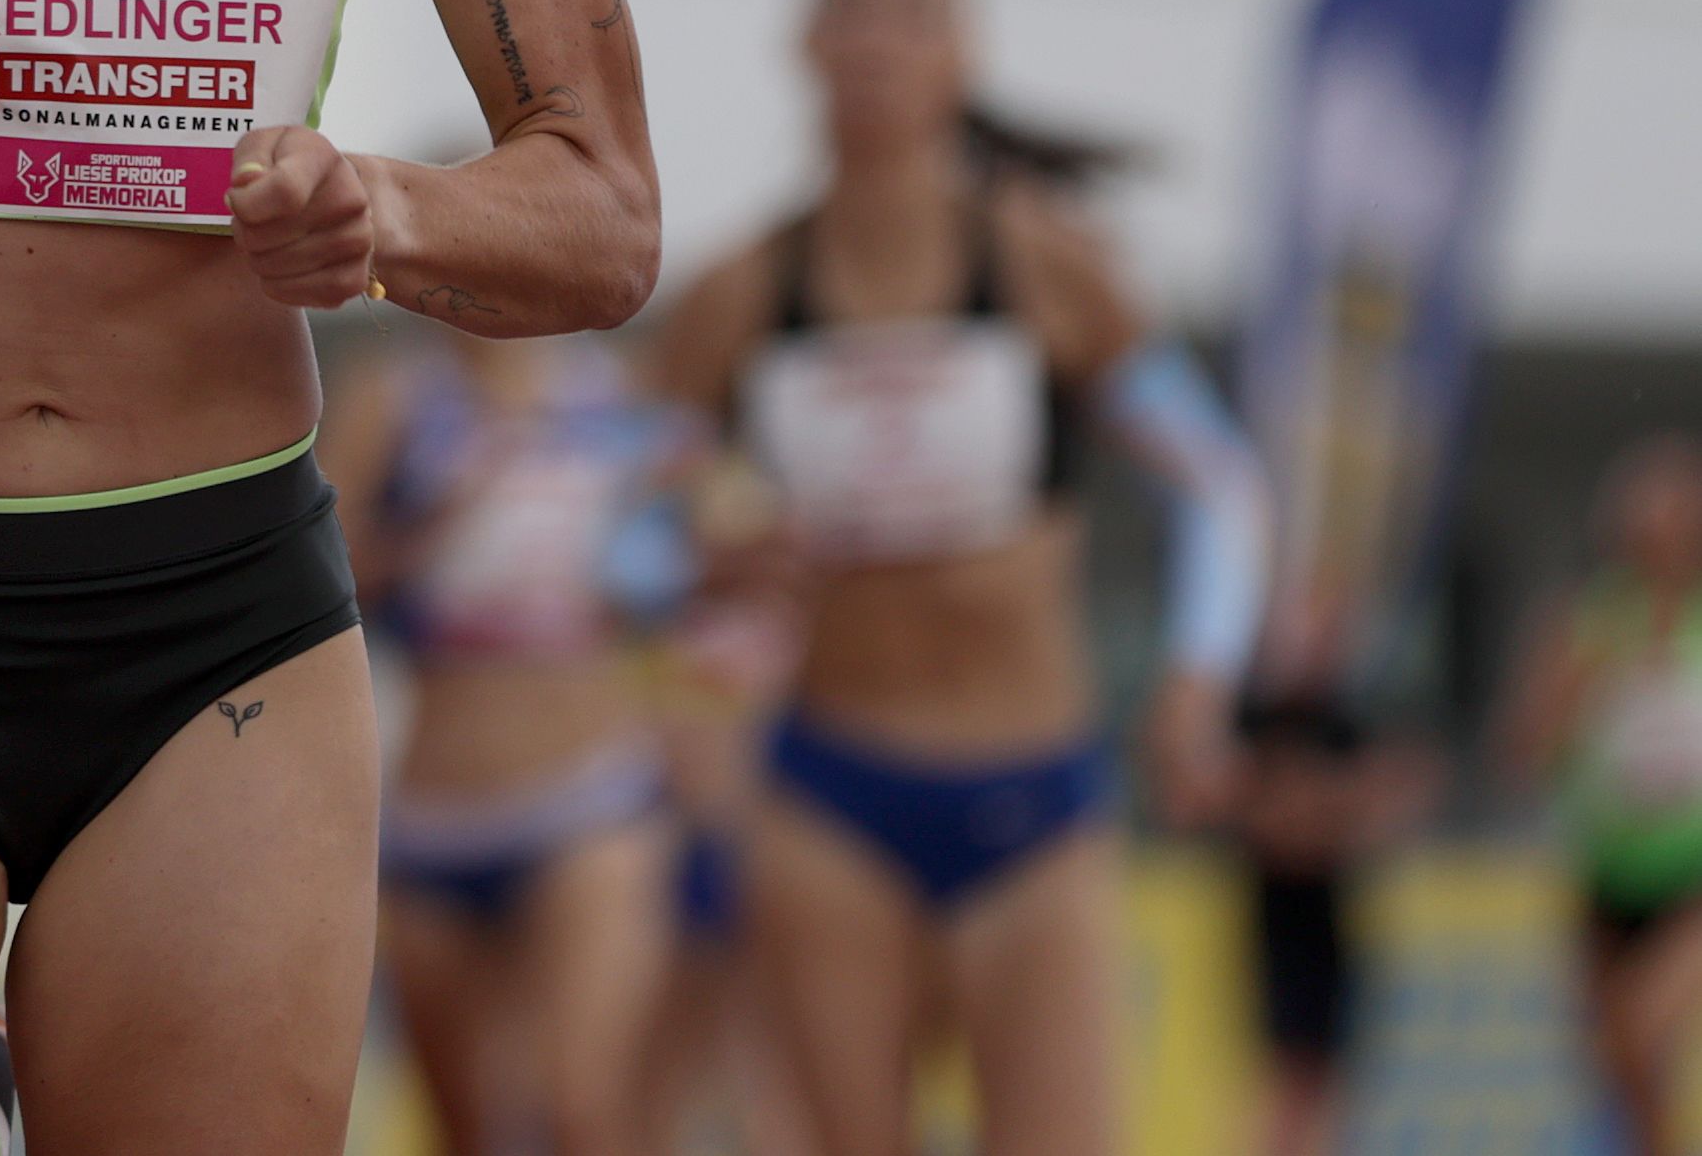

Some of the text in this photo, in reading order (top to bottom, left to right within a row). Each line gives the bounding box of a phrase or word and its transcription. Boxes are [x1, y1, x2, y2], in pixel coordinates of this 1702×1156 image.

[2, 59, 248, 101] TRANSFER
[90, 153, 162, 167] SPORTUNION
[64, 164, 187, 185] LIESE PROKOP
[65, 184, 185, 209] MEMORIAL
